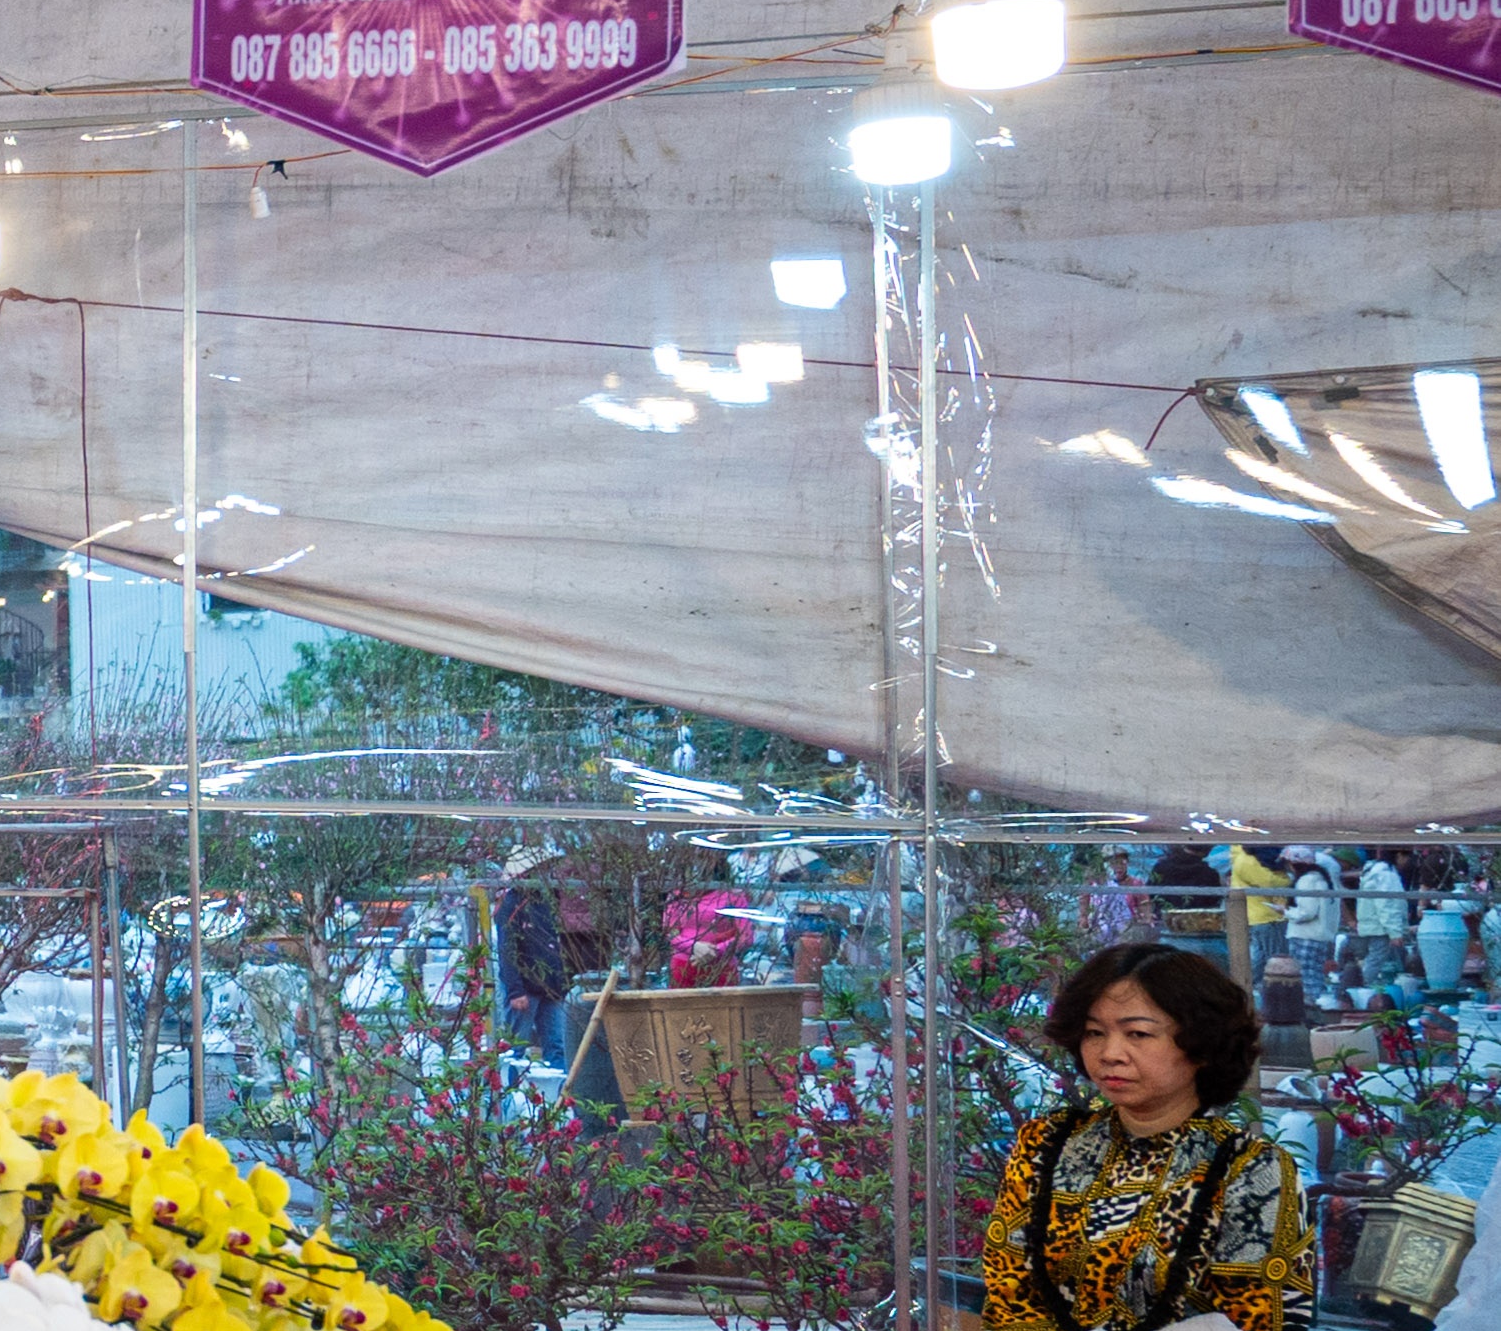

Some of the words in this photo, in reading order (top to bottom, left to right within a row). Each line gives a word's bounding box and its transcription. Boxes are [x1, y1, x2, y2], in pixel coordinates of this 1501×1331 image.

[230, 35, 282, 83] 087
[288, 32, 341, 81] 885
[347, 28, 417, 77] 6666
[442, 24, 497, 75] 085
[503, 22, 558, 72] 363
[564, 17, 638, 69] 9999
